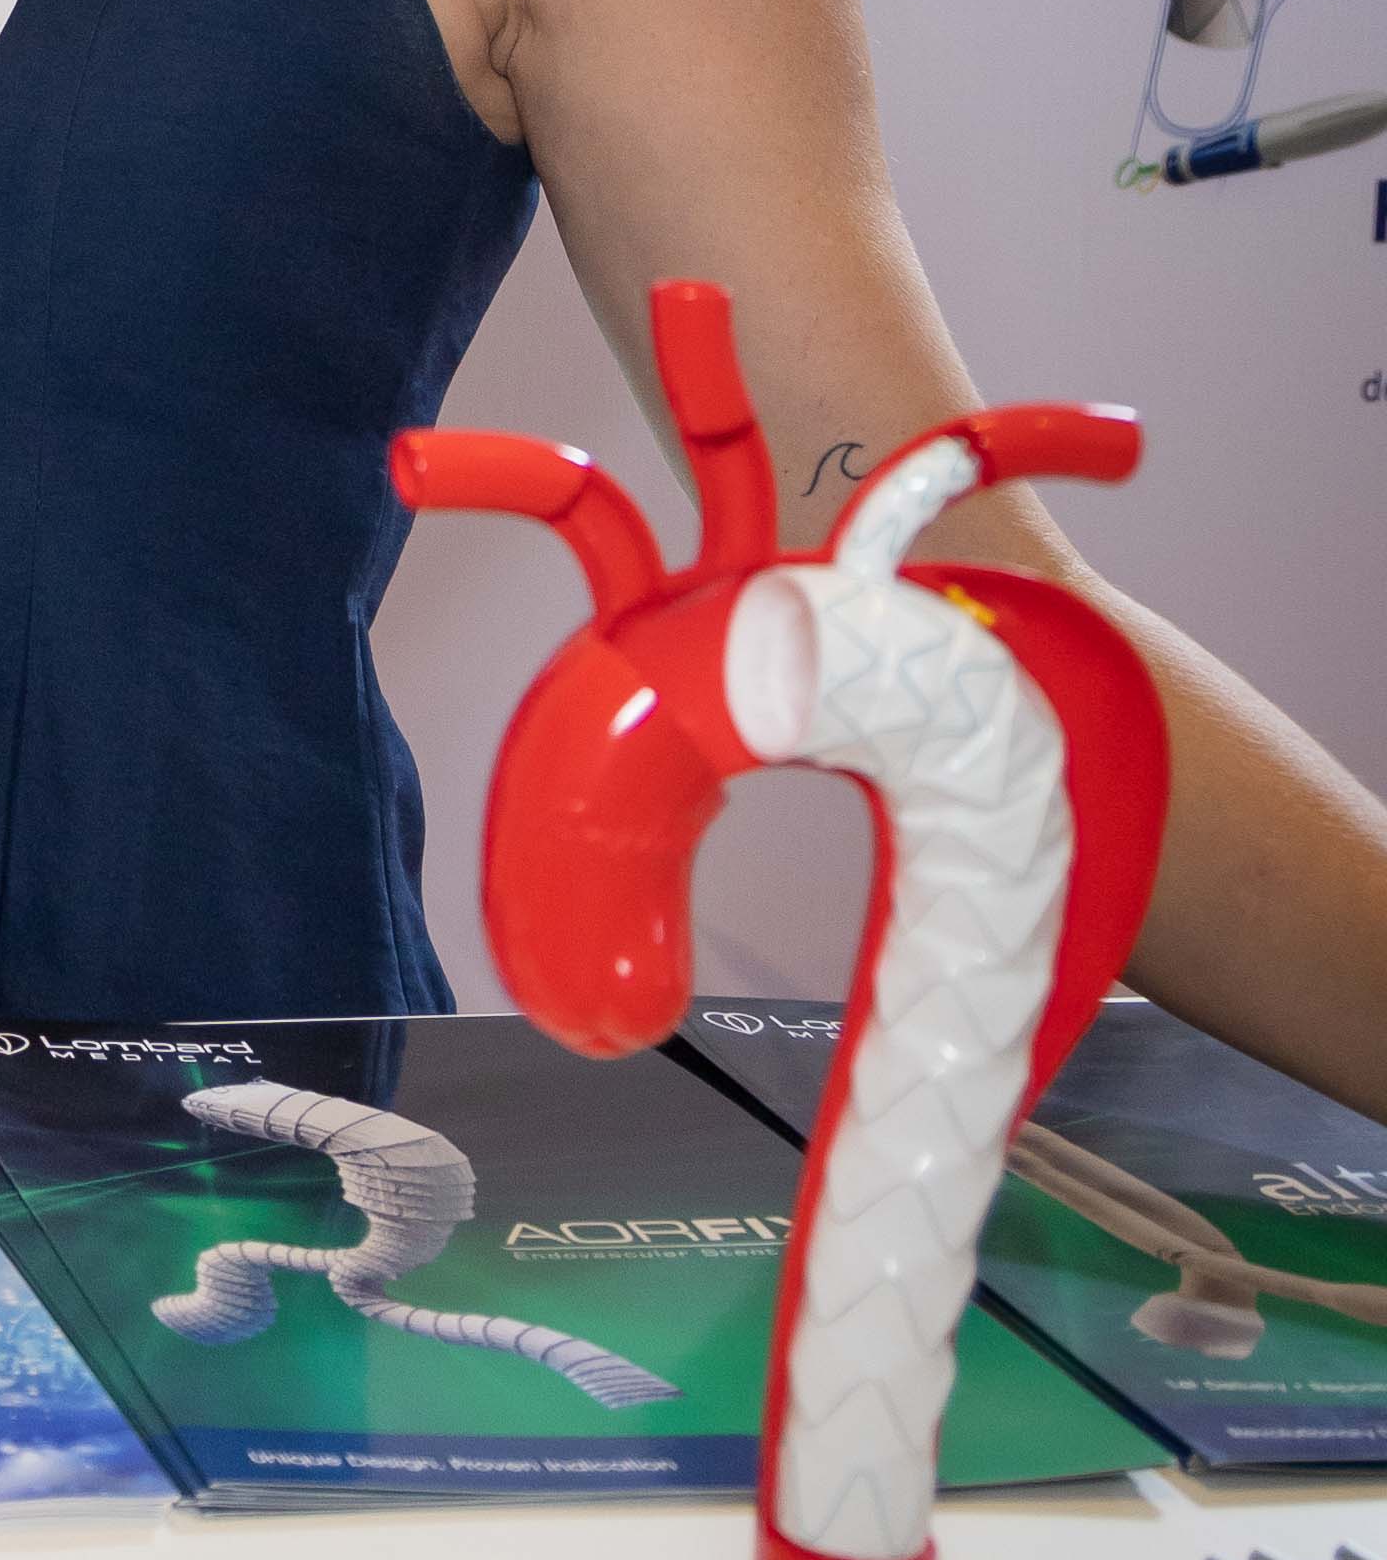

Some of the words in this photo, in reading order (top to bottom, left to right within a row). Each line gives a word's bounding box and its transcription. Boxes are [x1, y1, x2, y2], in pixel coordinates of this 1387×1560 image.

[39, 1035, 254, 1055] Lombard
[50, 1050, 262, 1064] MEDICAL
[513, 1249, 691, 1262] Endovascular
[247, 1448, 342, 1468] Unique
[448, 1453, 541, 1472] Proven
[541, 1455, 678, 1472] Indication
